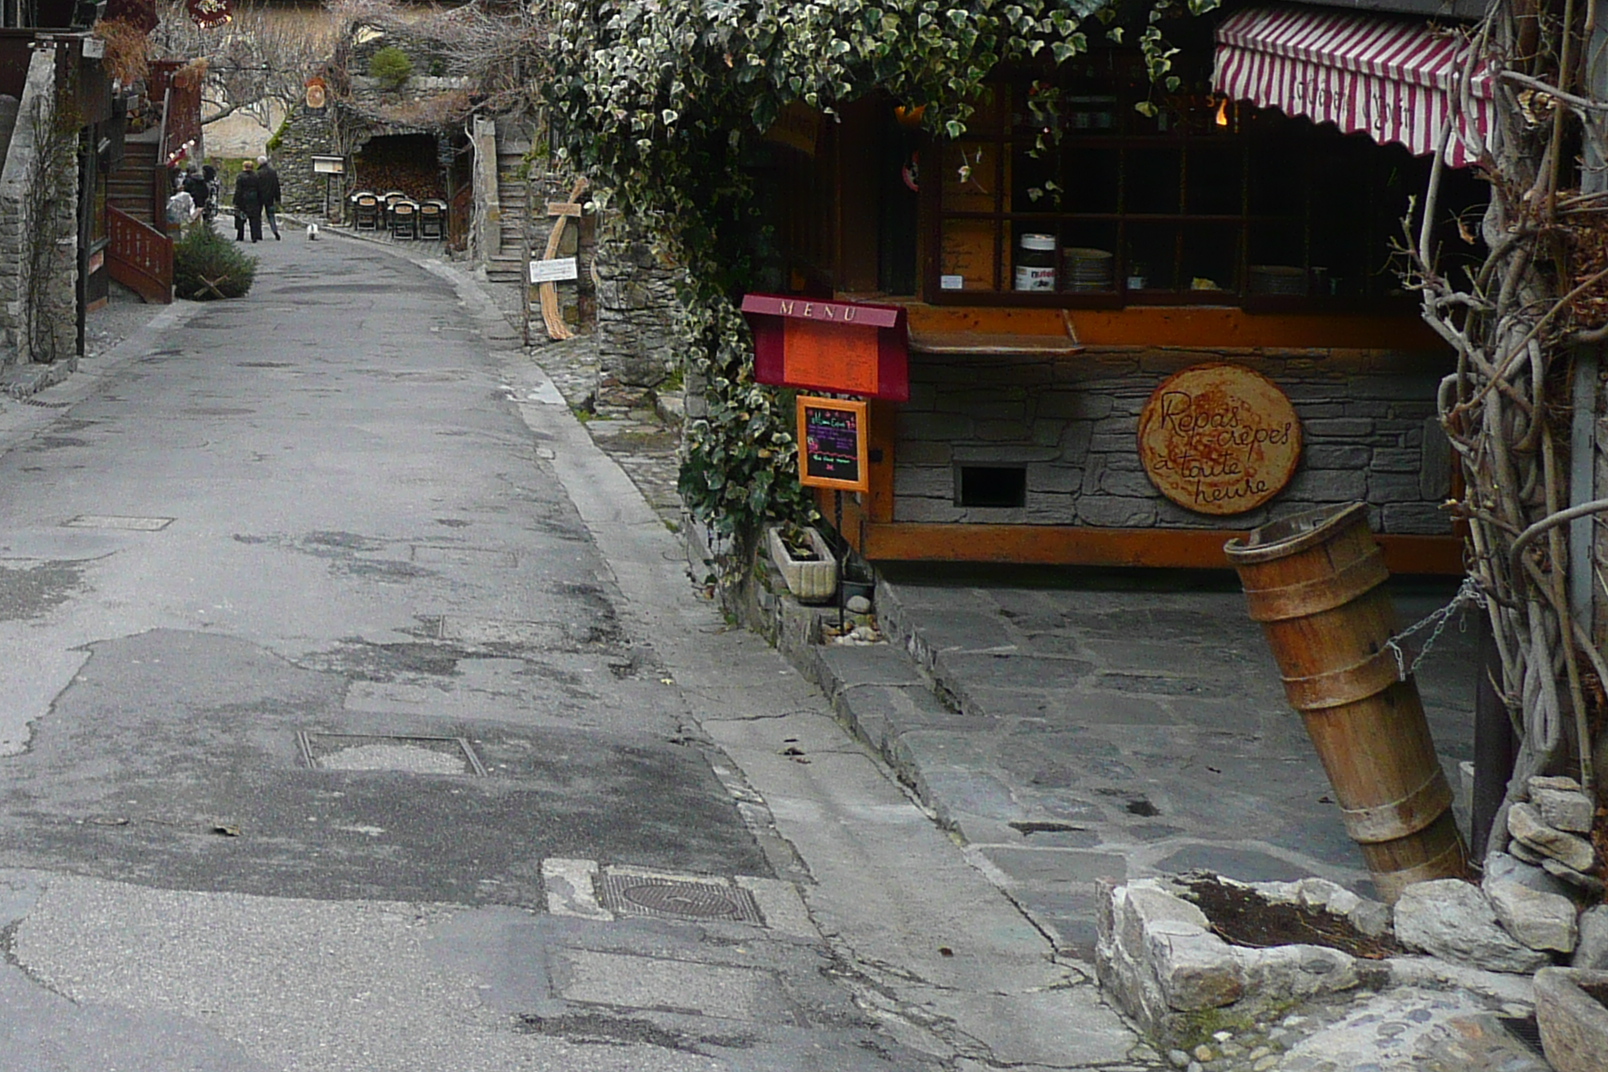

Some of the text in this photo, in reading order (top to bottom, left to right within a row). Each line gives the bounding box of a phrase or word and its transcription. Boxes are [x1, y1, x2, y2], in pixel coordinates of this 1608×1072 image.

[779, 300, 857, 321] MENU
[1160, 391, 1240, 447] Repas
[1154, 450, 1241, 478] à toute
[1194, 478, 1269, 504] heure
